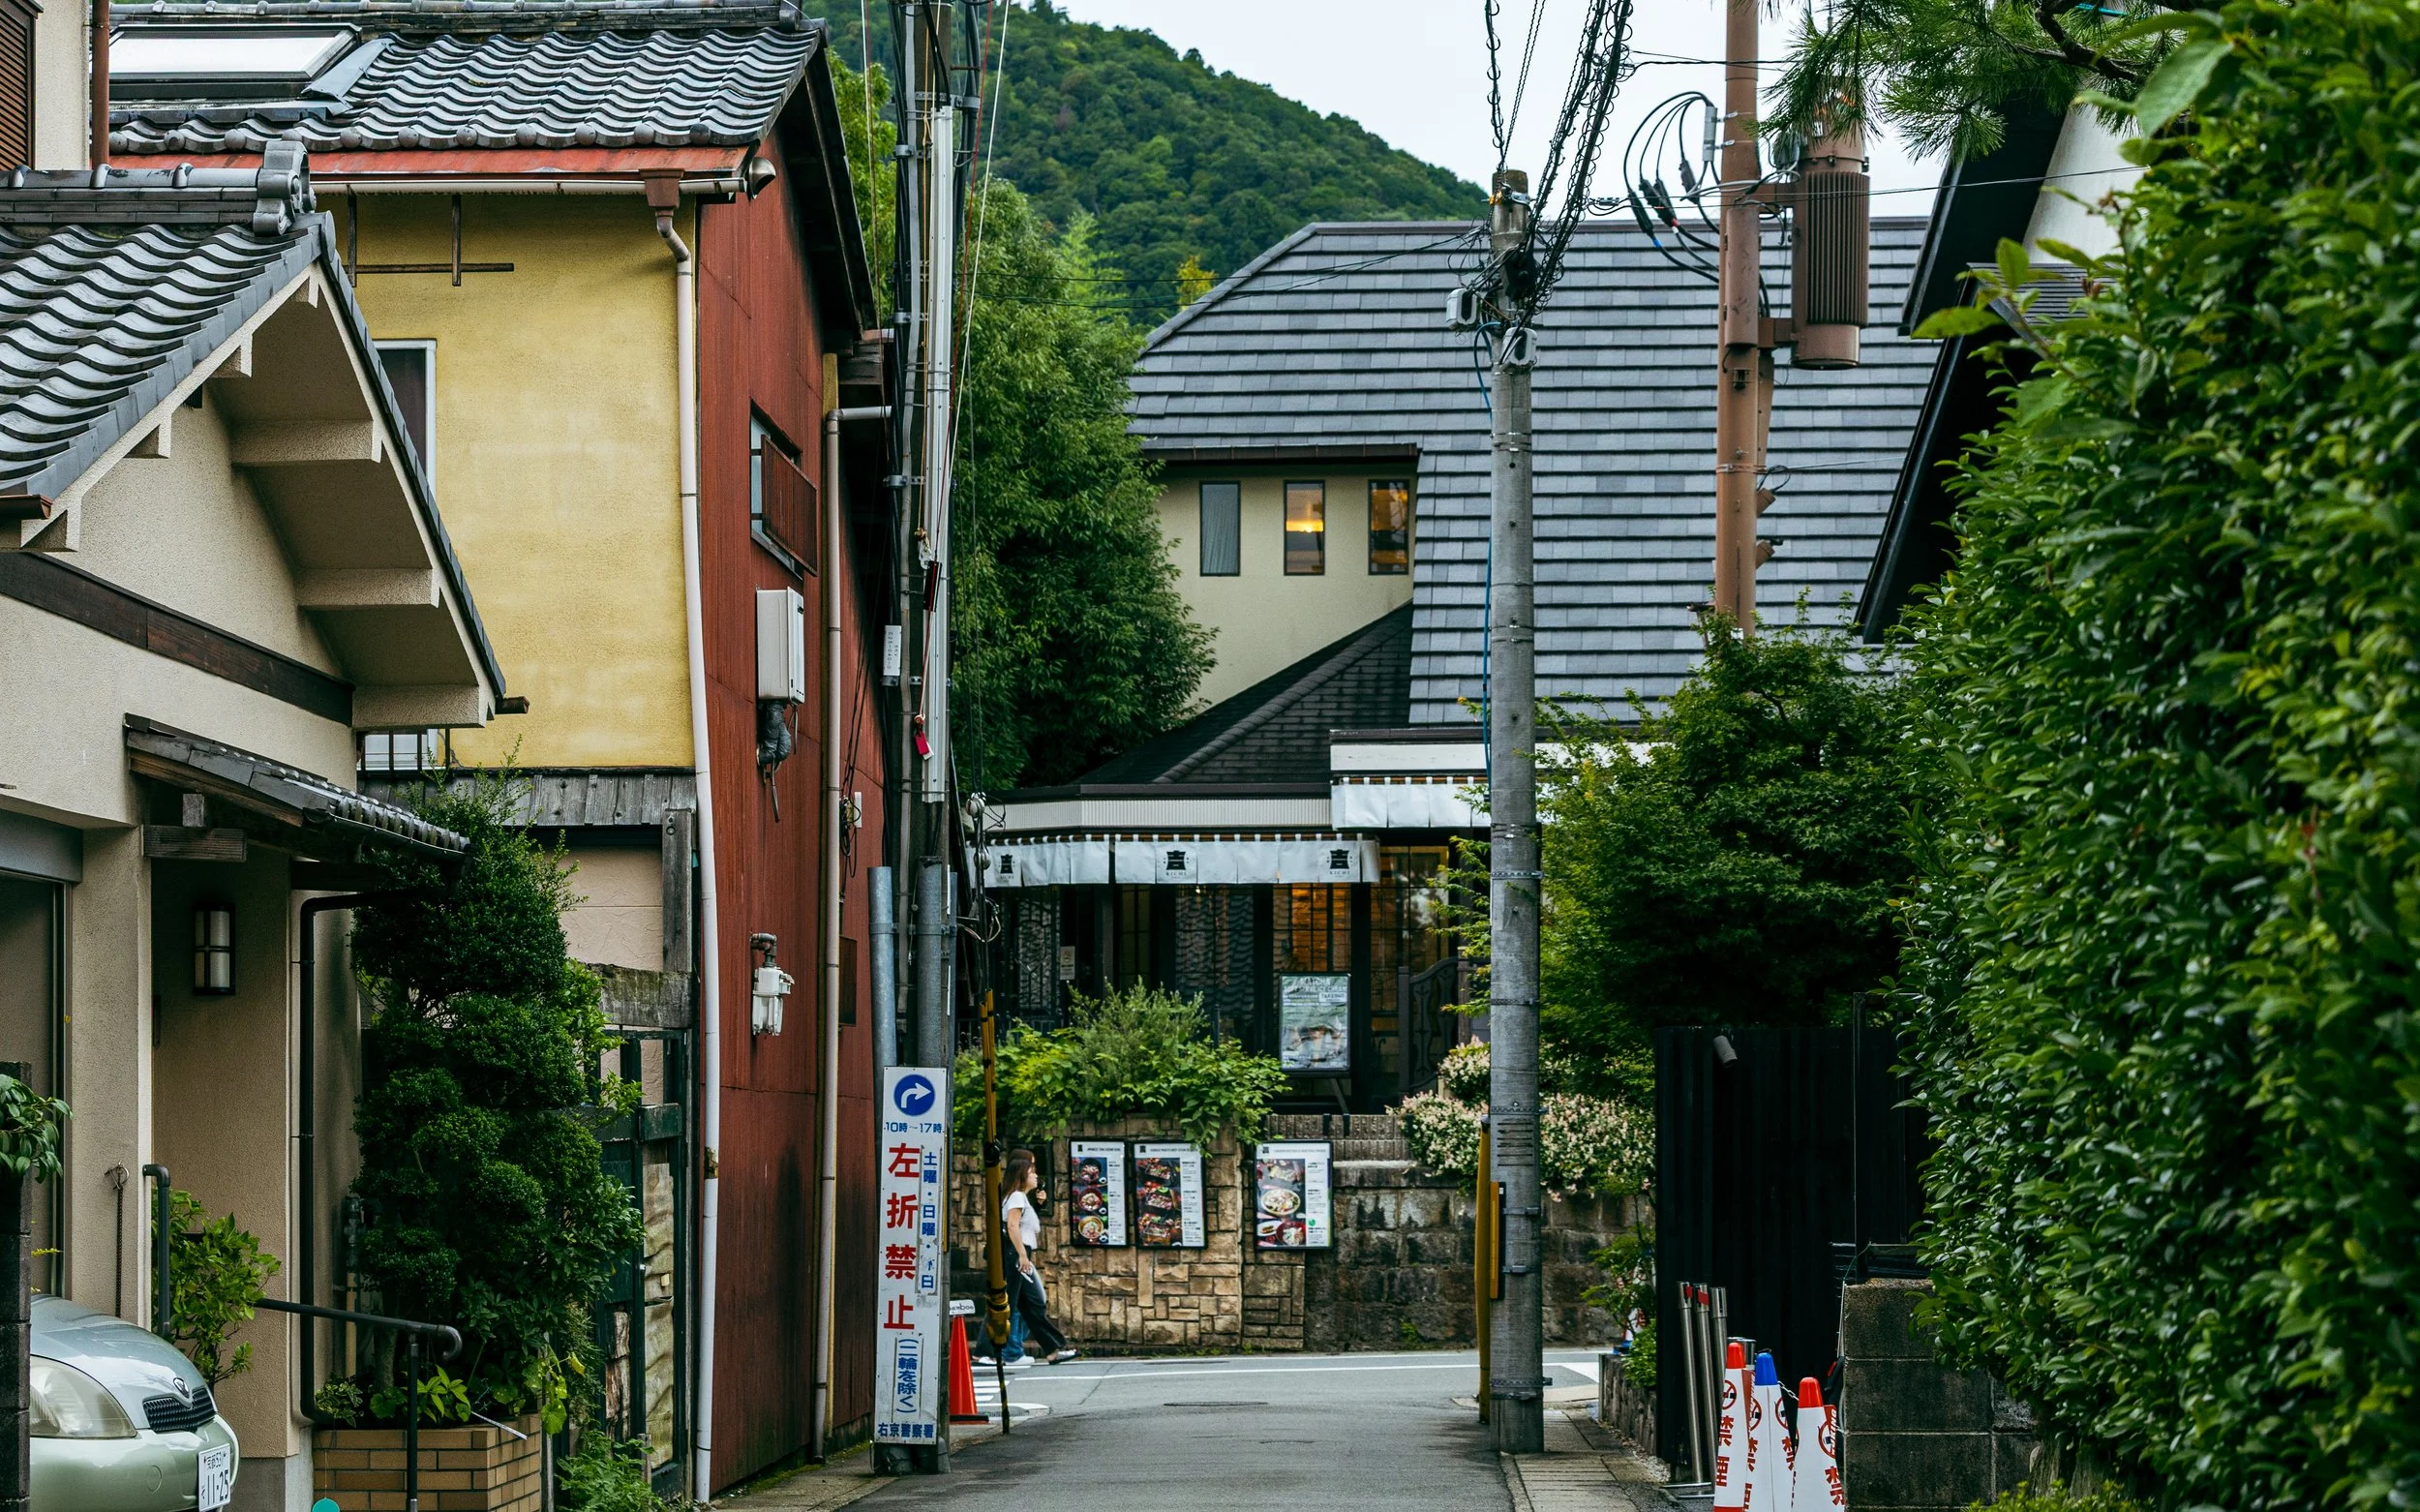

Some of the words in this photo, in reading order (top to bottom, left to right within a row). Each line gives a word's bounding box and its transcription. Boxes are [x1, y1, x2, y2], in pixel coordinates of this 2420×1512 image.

[884, 1143, 921, 1330] 左折禁止
[921, 1152, 937, 1288] 土曜・日曜・日
[895, 1339, 919, 1413] （二輪を除く）
[877, 1422, 934, 1438] 右京警察署
